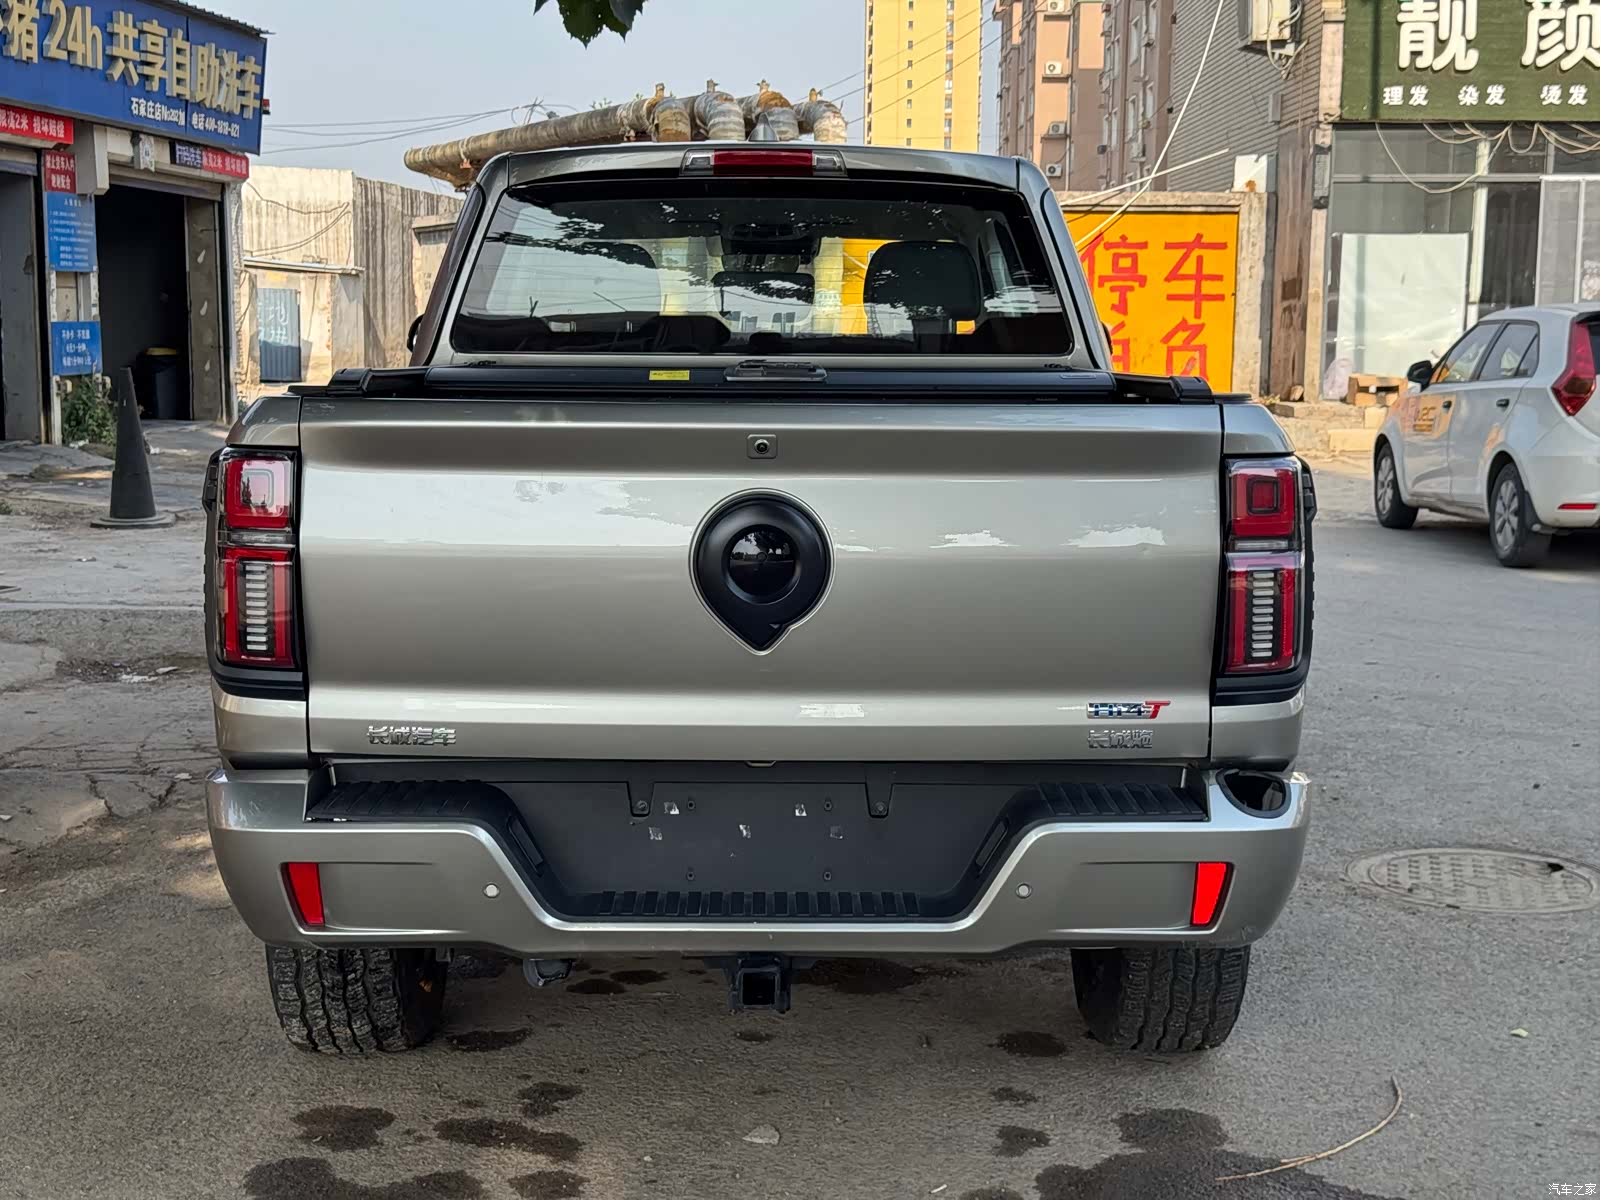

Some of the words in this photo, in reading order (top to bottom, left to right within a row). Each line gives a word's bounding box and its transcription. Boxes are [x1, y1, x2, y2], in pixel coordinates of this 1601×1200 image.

[1382, 85, 1429, 106] 理发
[1458, 84, 1506, 106] 染发
[1540, 85, 1588, 106] 烫发
[1079, 232, 1228, 319] 停车
[366, 725, 456, 746] 长城汽车
